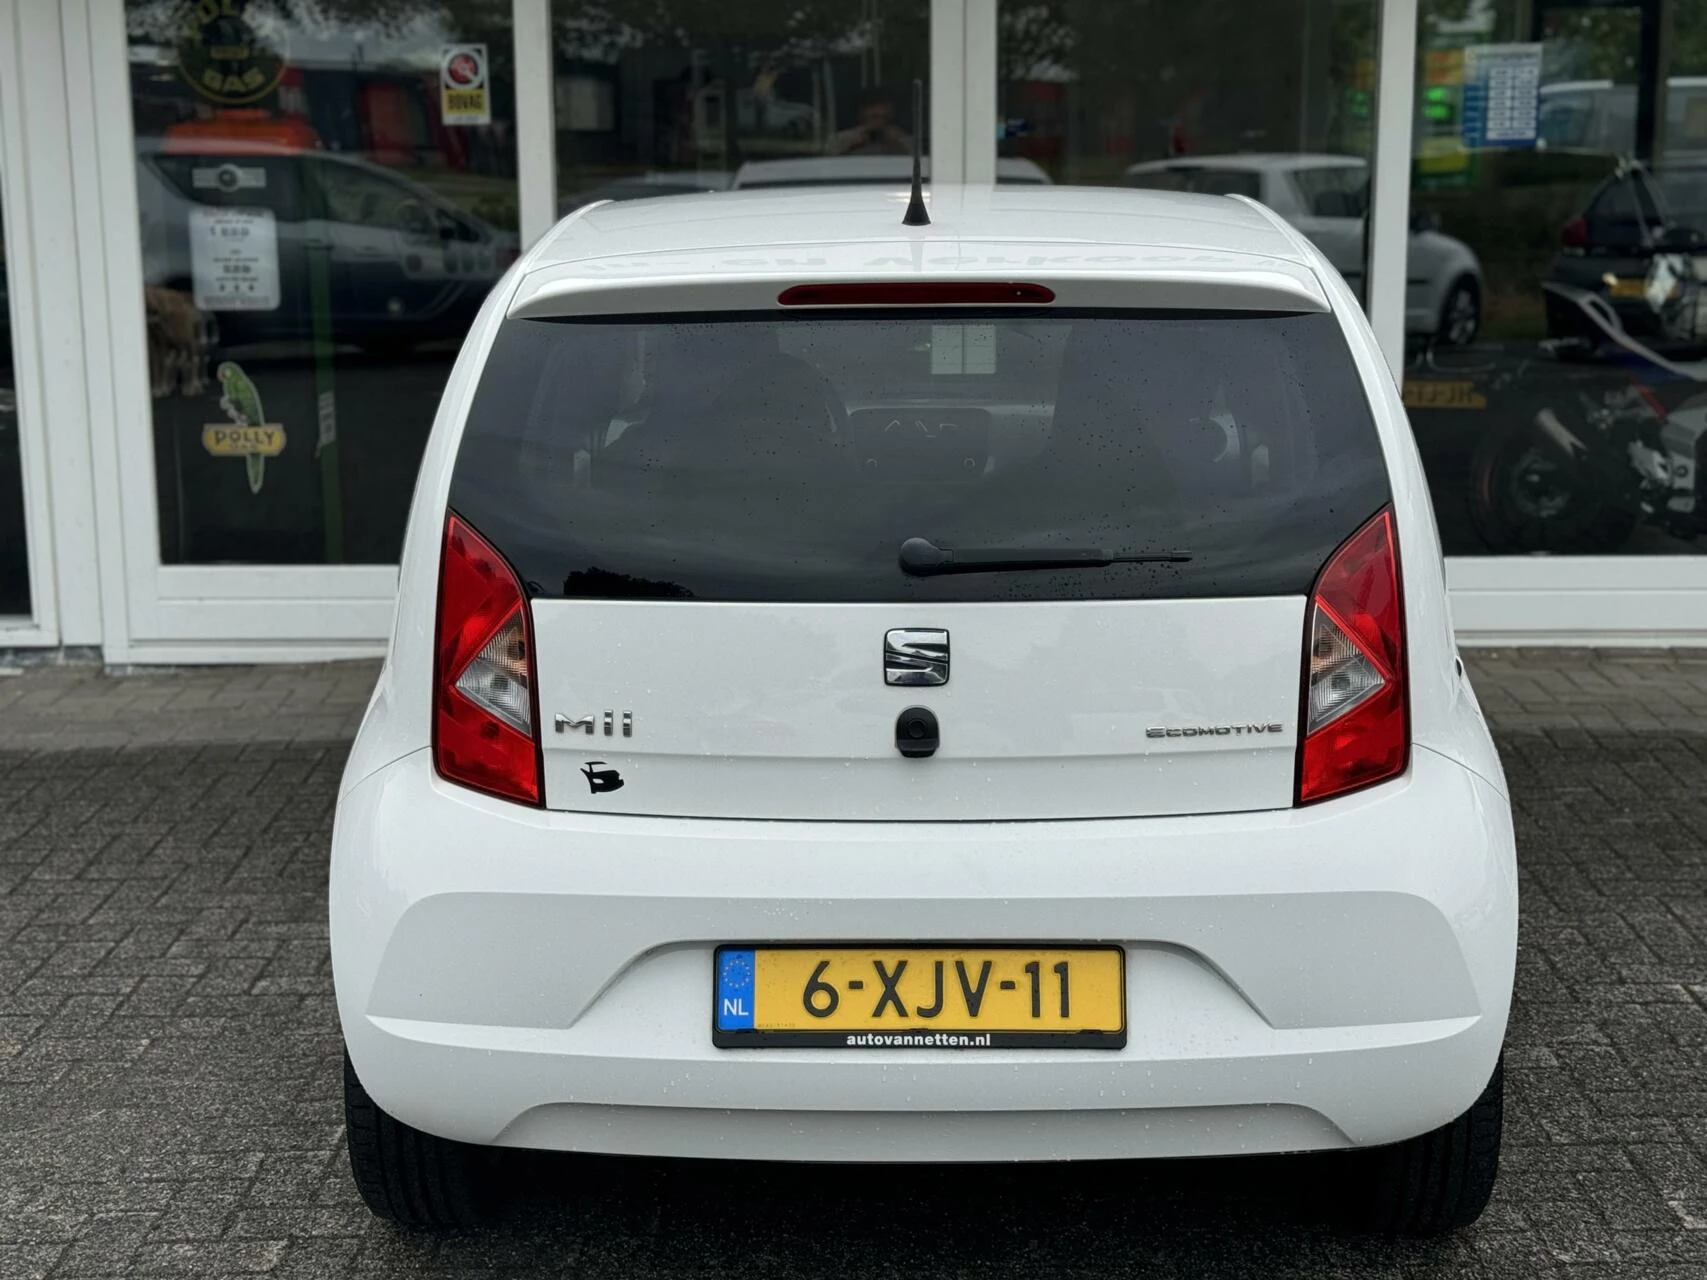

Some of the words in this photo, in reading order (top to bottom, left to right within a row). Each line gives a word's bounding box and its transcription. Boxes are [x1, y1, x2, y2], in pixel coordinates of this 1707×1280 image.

[215, 430, 274, 446] POLLY
[1146, 724, 1282, 738] ECOMOTIVE
[803, 960, 1070, 1018] 6-XJV-11
[723, 998, 748, 1016] NL
[846, 1033, 991, 1046] autovannetten.nl
